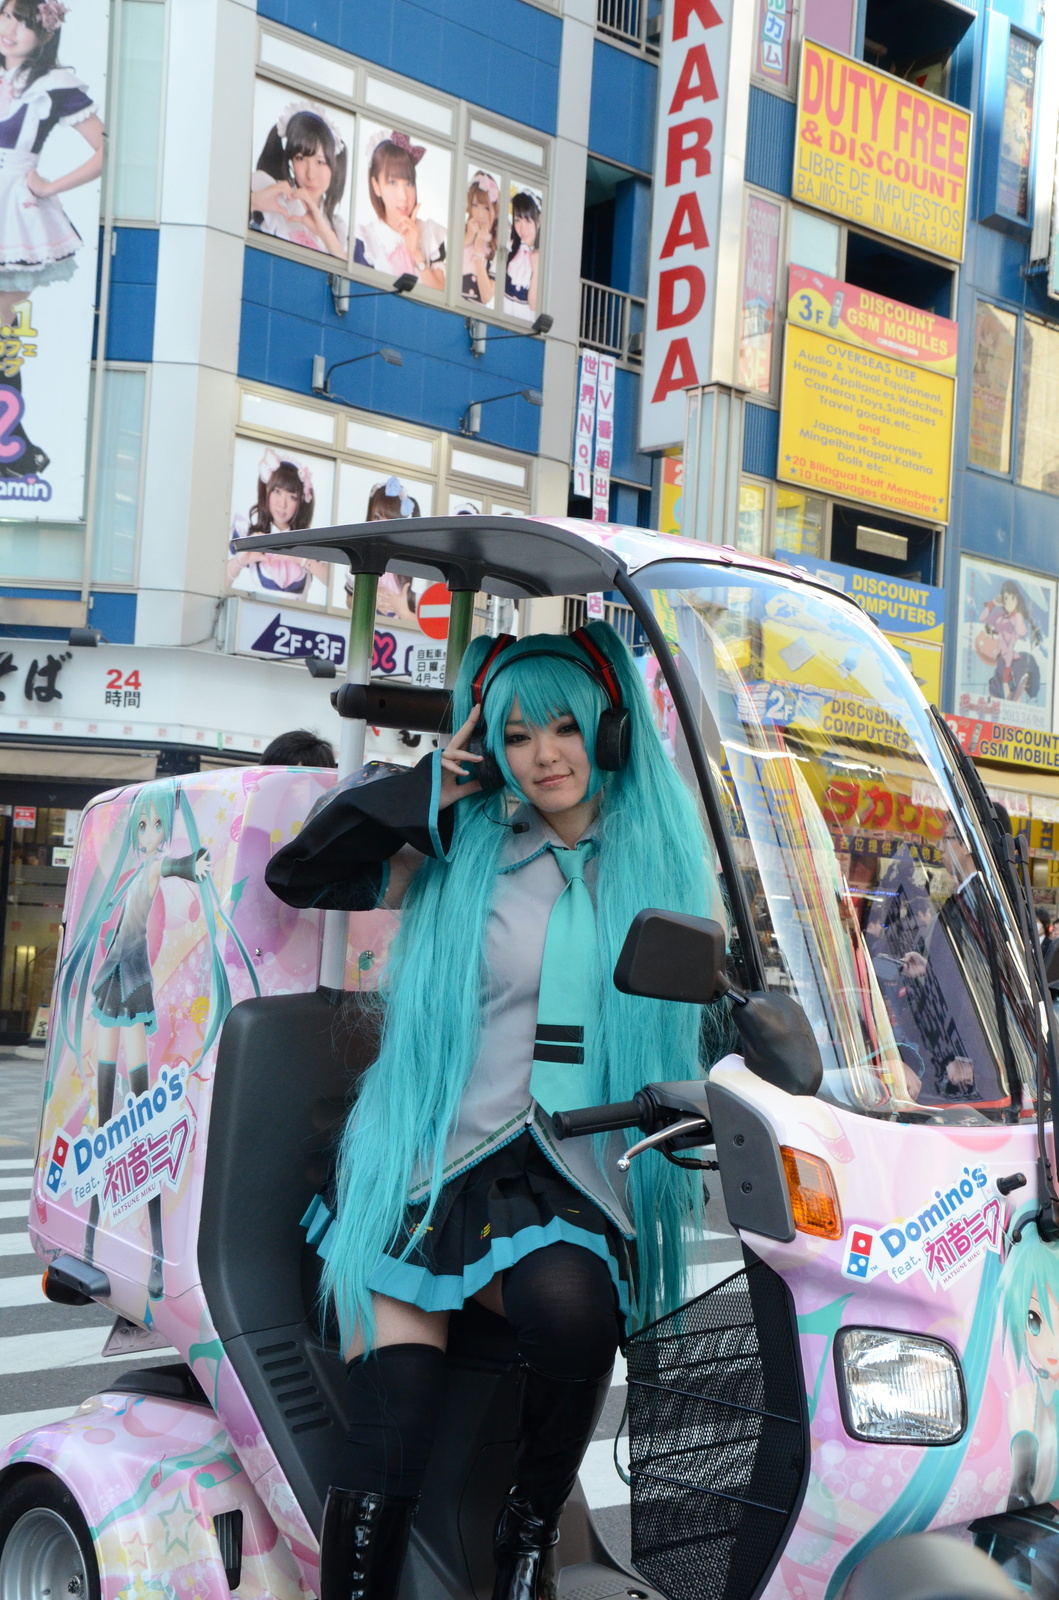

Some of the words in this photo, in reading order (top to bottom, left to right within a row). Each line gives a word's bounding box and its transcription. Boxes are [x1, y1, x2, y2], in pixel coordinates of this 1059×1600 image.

[802, 47, 888, 143] DUTY
[893, 89, 967, 180] FREE
[800, 119, 823, 149] &
[829, 129, 963, 204] DISCOUNT
[799, 146, 846, 187] LIBRE
[850, 167, 871, 197] DE
[874, 177, 961, 232] IMPUESTOS
[746, 207, 779, 238] iscount
[0, 301, 38, 337] .1
[798, 294, 824, 324] 3F
[859, 292, 936, 333] DISCOUNT
[846, 307, 880, 334] GSM
[884, 319, 948, 356] MOBILES
[793, 360, 829, 379] Home
[798, 349, 833, 368] Audio
[836, 361, 844, 371] &
[847, 364, 881, 384] Visual
[825, 343, 891, 375] OVERSEAS
[895, 366, 917, 383] USE
[819, 395, 853, 414] Travel
[812, 418, 869, 444] Japanese
[872, 436, 923, 460] Souvenirs
[857, 422, 881, 437] and
[837, 452, 863, 468] Dolls
[792, 455, 807, 467] 20
[809, 460, 857, 482] Bilingual
[860, 474, 884, 489] Staff
[886, 481, 937, 504] Members
[799, 468, 812, 480] 10
[815, 472, 877, 499] Languages
[880, 490, 931, 514] available
[852, 574, 930, 607] DISCOUNT
[106, 668, 142, 691] 24
[104, 690, 141, 709] 時間
[766, 690, 793, 721] 2F
[823, 715, 911, 750] COMPUTERS
[980, 740, 1009, 759] GSM
[993, 724, 1059, 750] DISCOUNT
[73, 1069, 184, 1176] Domino's
[103, 1118, 189, 1204] 初音ミク
[74, 1175, 101, 1202] feat.
[112, 1194, 140, 1219] HATSUNE
[141, 1182, 157, 1199] MIKU
[879, 1166, 988, 1259] Domino's
[924, 1199, 1000, 1273] 初音ミク
[891, 1253, 922, 1279] feat.
[942, 1262, 968, 1284] HATSUNE
[967, 1250, 981, 1265] MIKU
